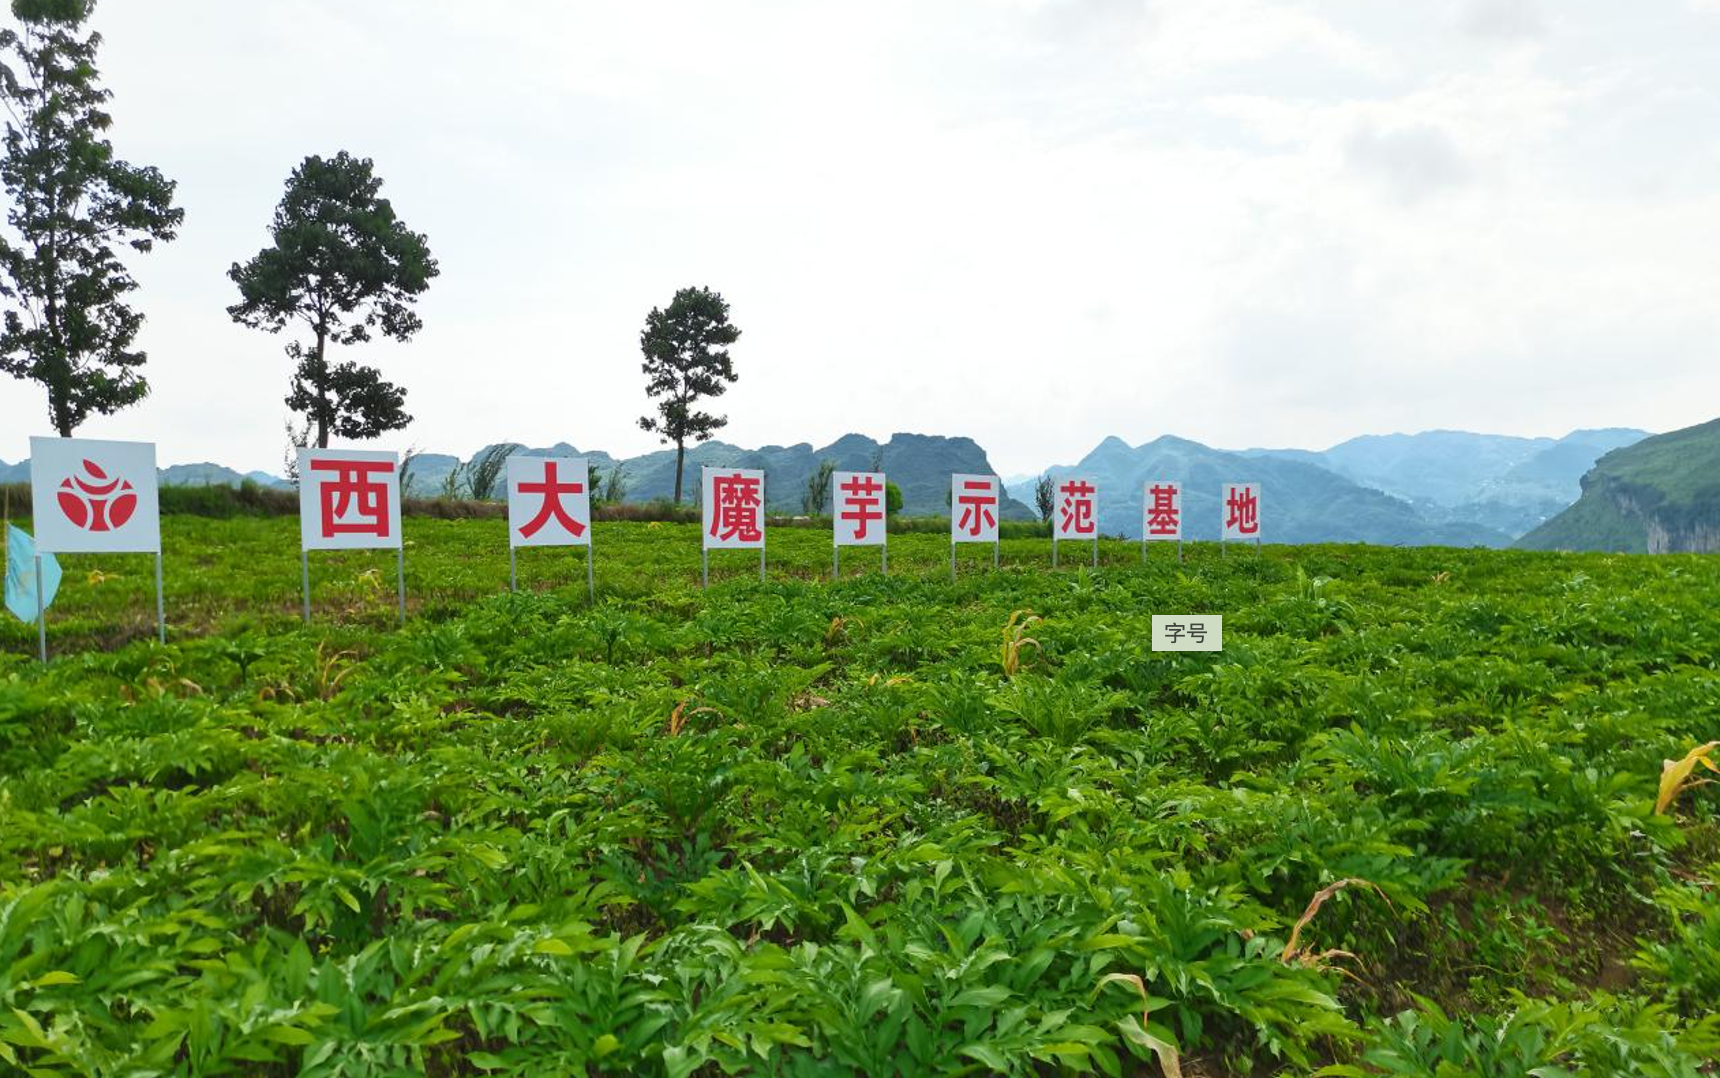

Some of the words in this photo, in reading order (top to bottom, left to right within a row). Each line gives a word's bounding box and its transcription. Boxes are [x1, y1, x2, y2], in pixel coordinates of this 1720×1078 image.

[310, 459, 394, 538] 西
[518, 461, 586, 538] 大
[710, 474, 764, 542] 魔
[841, 477, 884, 540] 芋
[958, 481, 996, 537] 示
[1060, 480, 1096, 534] 范
[1146, 485, 1180, 535] 基
[1226, 488, 1259, 534] 地
